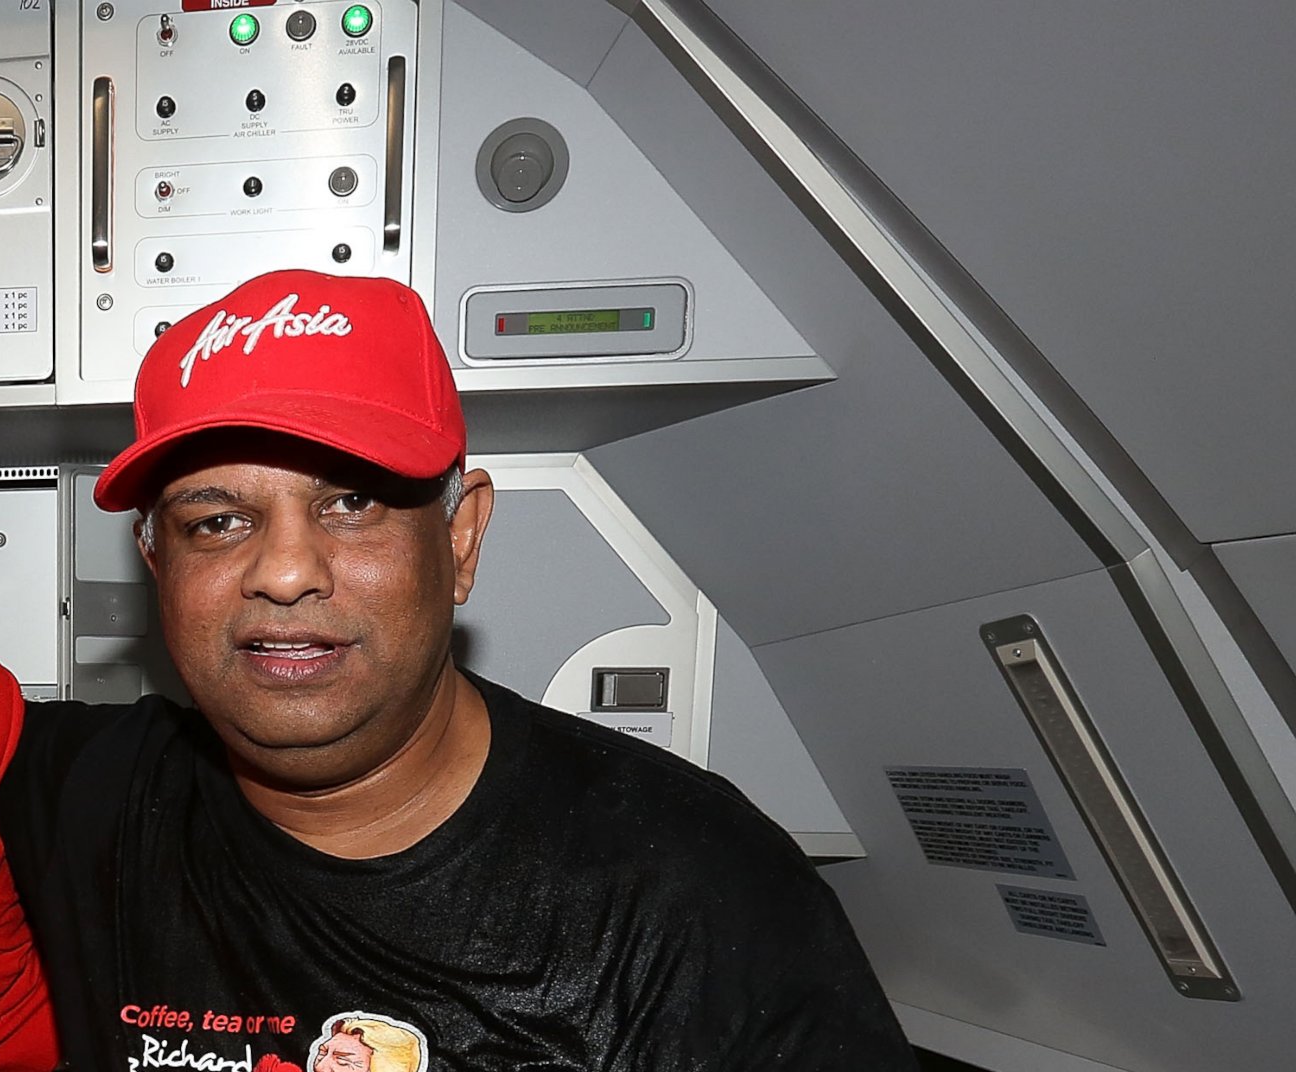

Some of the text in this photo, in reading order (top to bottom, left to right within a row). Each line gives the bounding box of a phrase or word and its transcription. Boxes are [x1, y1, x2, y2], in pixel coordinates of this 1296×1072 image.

[291, 43, 312, 51] FAULT
[338, 46, 375, 55] AVAILABLE
[249, 113, 260, 121] DC
[241, 121, 268, 129] SUPPLY
[152, 128, 178, 136] SUPPLY
[246, 129, 276, 138] CHILLER
[154, 171, 180, 179] BRIGHT
[176, 187, 191, 195] OFF
[253, 207, 273, 215] LIGHT
[146, 276, 169, 284] WATER
[171, 275, 196, 283] BOILER
[18, 292, 28, 300] pc
[18, 302, 28, 310] pc
[18, 323, 28, 331] pc
[120, 1004, 296, 1034] Coffee, tea or me
